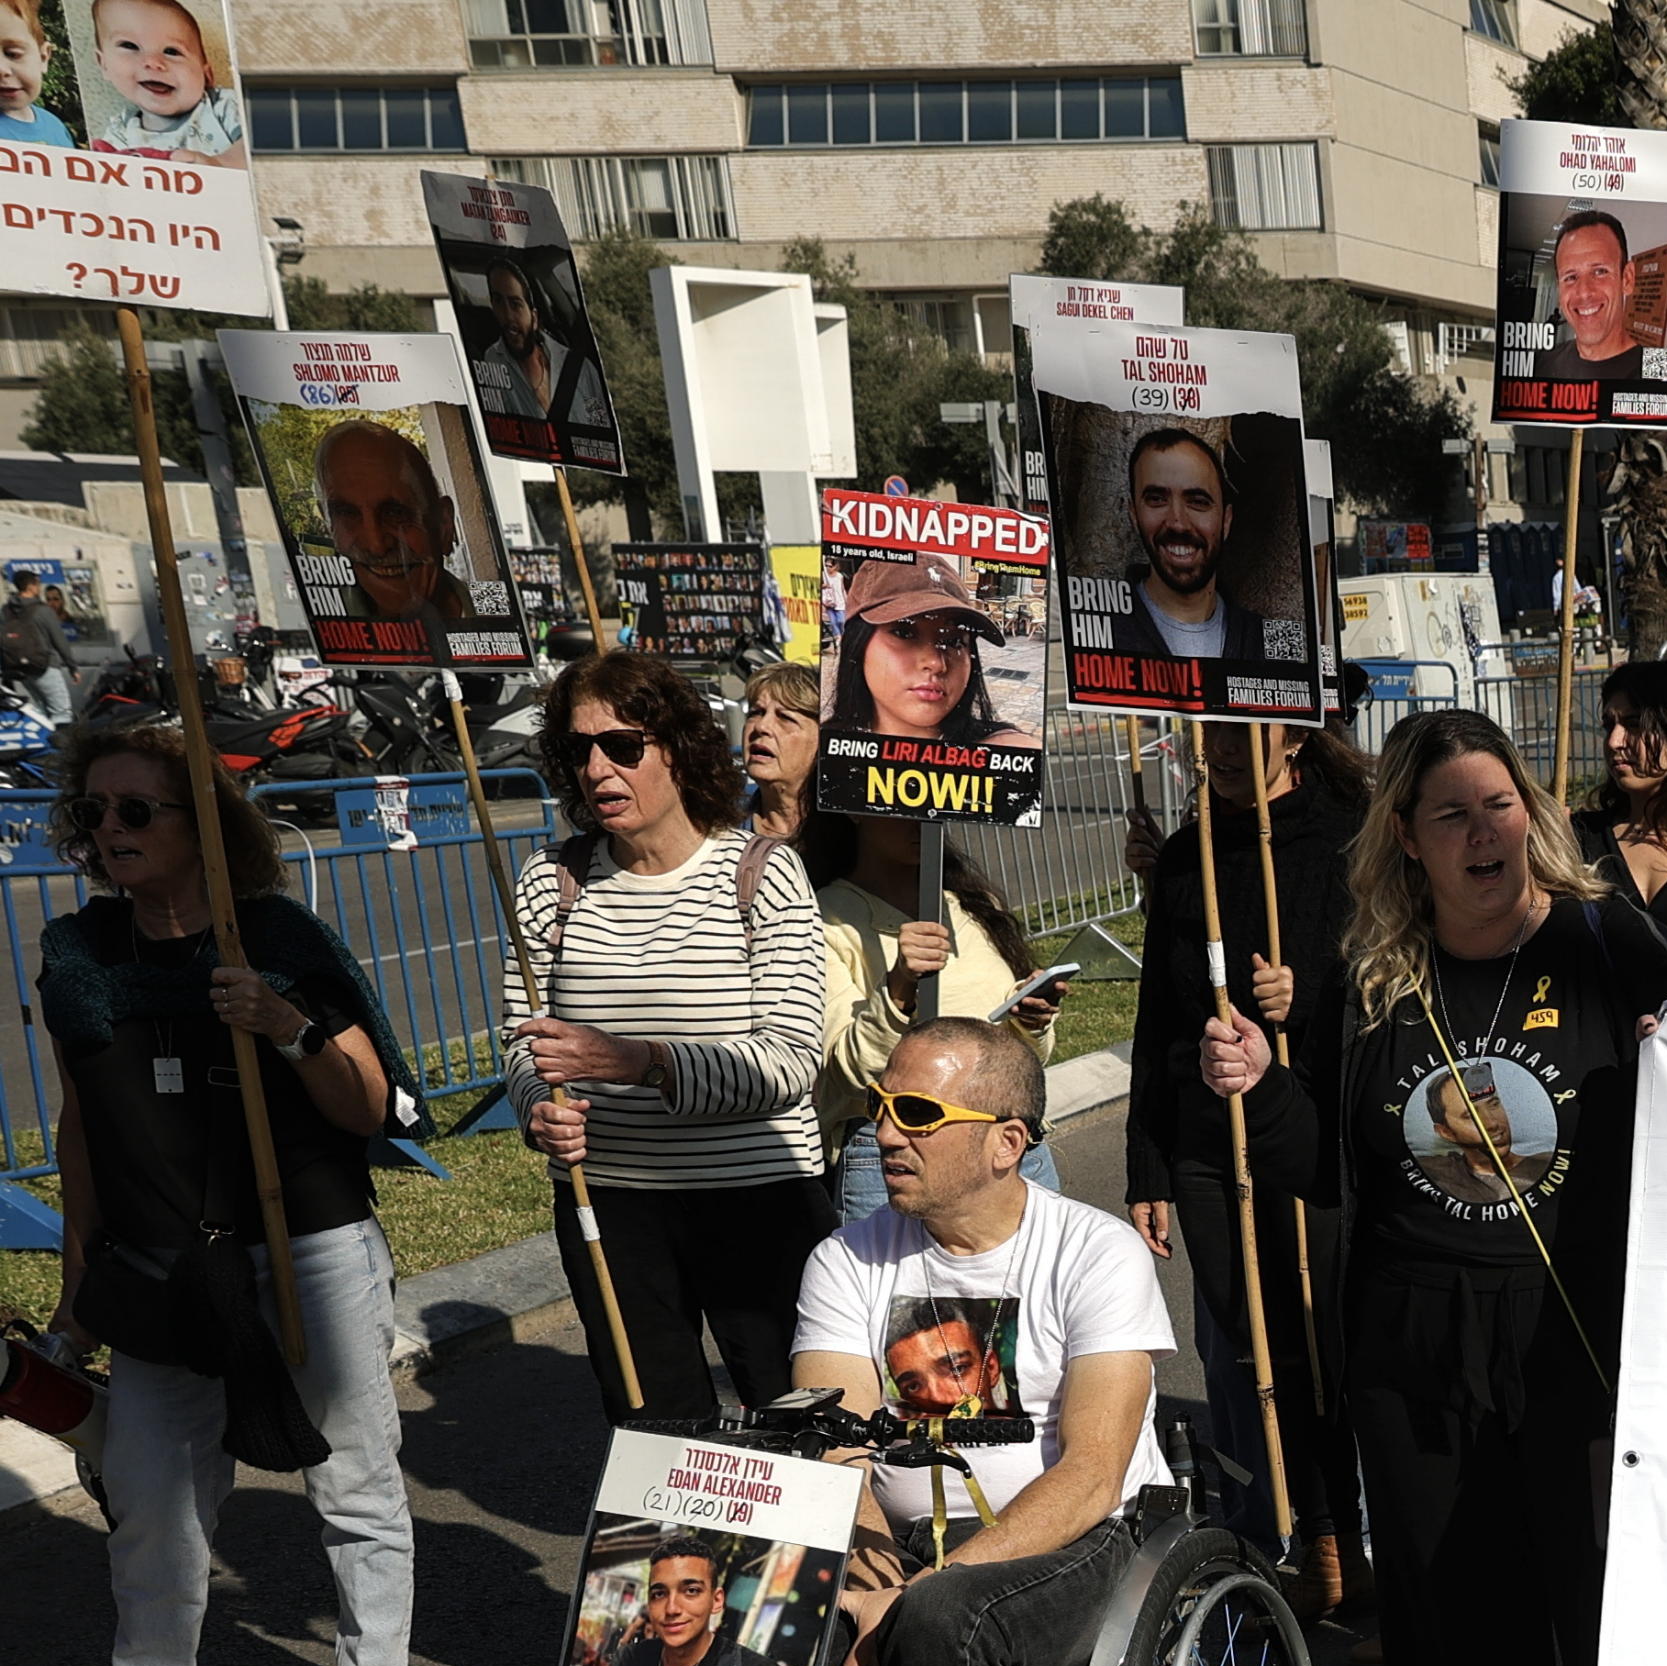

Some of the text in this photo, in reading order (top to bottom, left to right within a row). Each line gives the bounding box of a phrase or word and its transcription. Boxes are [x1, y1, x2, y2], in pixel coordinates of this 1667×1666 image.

[66, 160, 128, 186] אם
[1560, 152, 1636, 172] OHAD YAHALOMI
[143, 166, 204, 194] מה
[4, 204, 220, 250] היו הנכדים
[66, 262, 180, 298] שלך?
[1057, 303, 1134, 320] SAGUI DEKEL CHEN
[1136, 336, 1188, 359] טל שהם
[1504, 322, 1554, 349] BRING
[293, 363, 400, 382] SHLOMO MANTZUR
[1122, 359, 1207, 386] TAL SHOHAM
[1502, 351, 1534, 377] HIM
[1132, 387, 1169, 410] (39)
[831, 499, 1042, 554] KIDNAPPED
[831, 545, 913, 563] 18 years old, Israeli
[297, 555, 355, 586] BRING
[306, 585, 346, 616] HIM
[1067, 576, 1132, 614] BRING
[1070, 614, 1112, 649] HIM
[828, 738, 1034, 773] BRING LIRI ALBAG BACK
[867, 766, 994, 813] NOW!!
[1397, 1037, 1560, 1090] TAL SHOHAM
[1445, 1197, 1471, 1220] TAL
[1540, 1149, 1570, 1196] NOW!
[686, 1448, 774, 1481] עידן אלכסנדר
[667, 1469, 781, 1505] EDAN ALEXANDER
